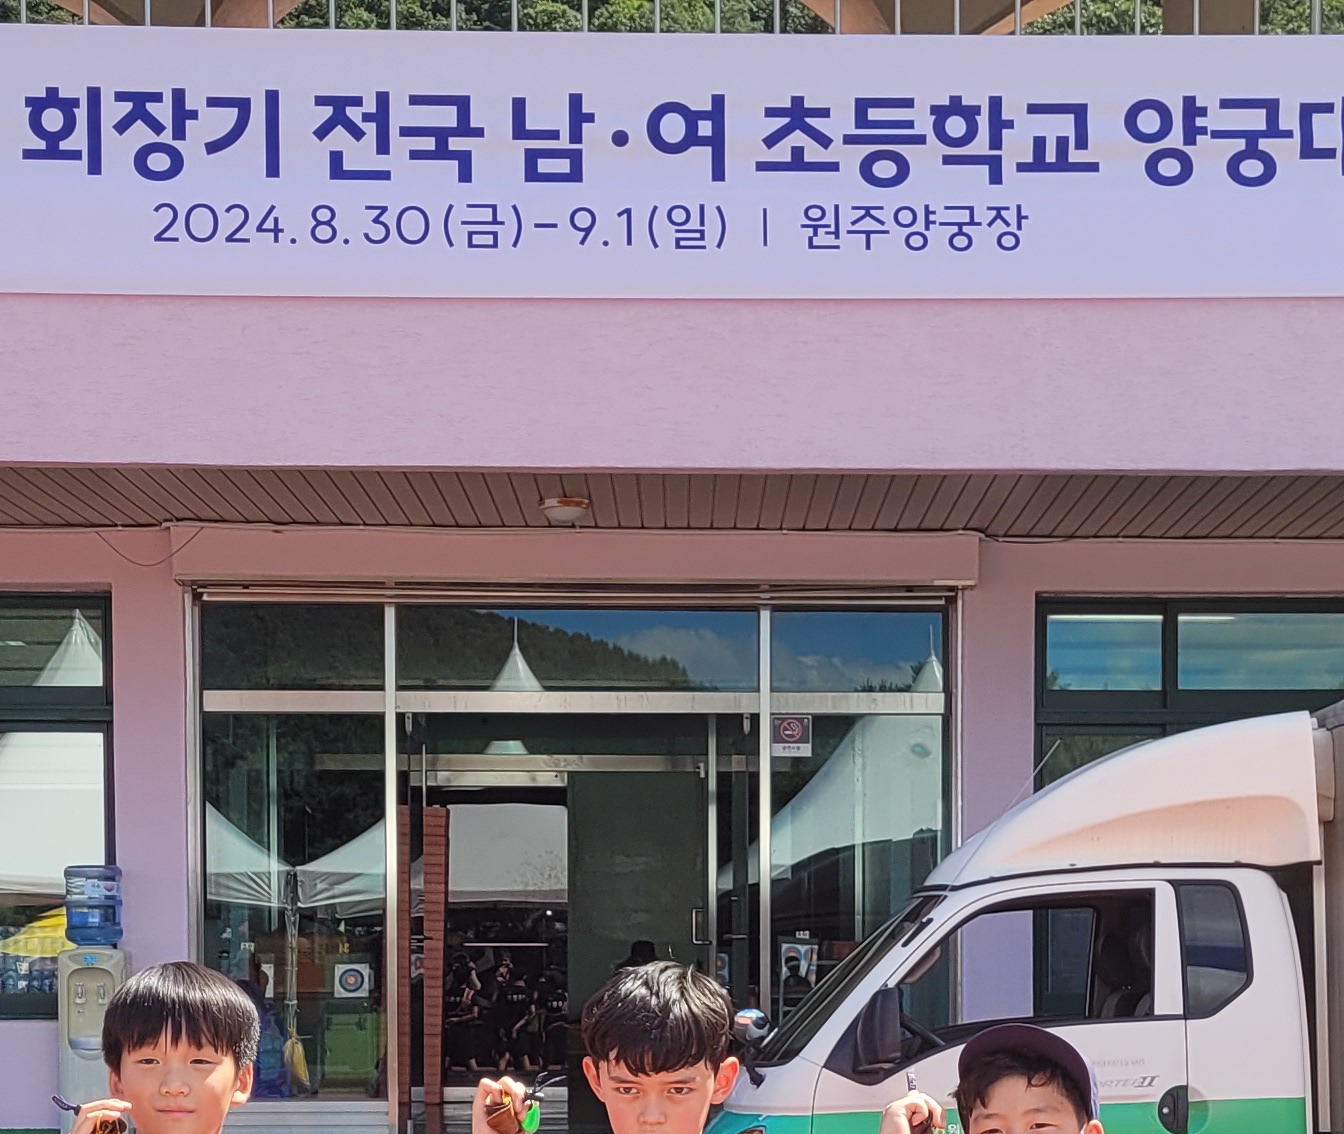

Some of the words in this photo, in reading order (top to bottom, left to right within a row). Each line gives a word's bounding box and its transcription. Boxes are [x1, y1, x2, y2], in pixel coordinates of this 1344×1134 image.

[21, 84, 281, 182] 회장기
[311, 89, 485, 184] 전국
[510, 92, 727, 184] 남·여
[754, 93, 1101, 188] 초등학교
[800, 203, 1030, 252] 원주양궁장
